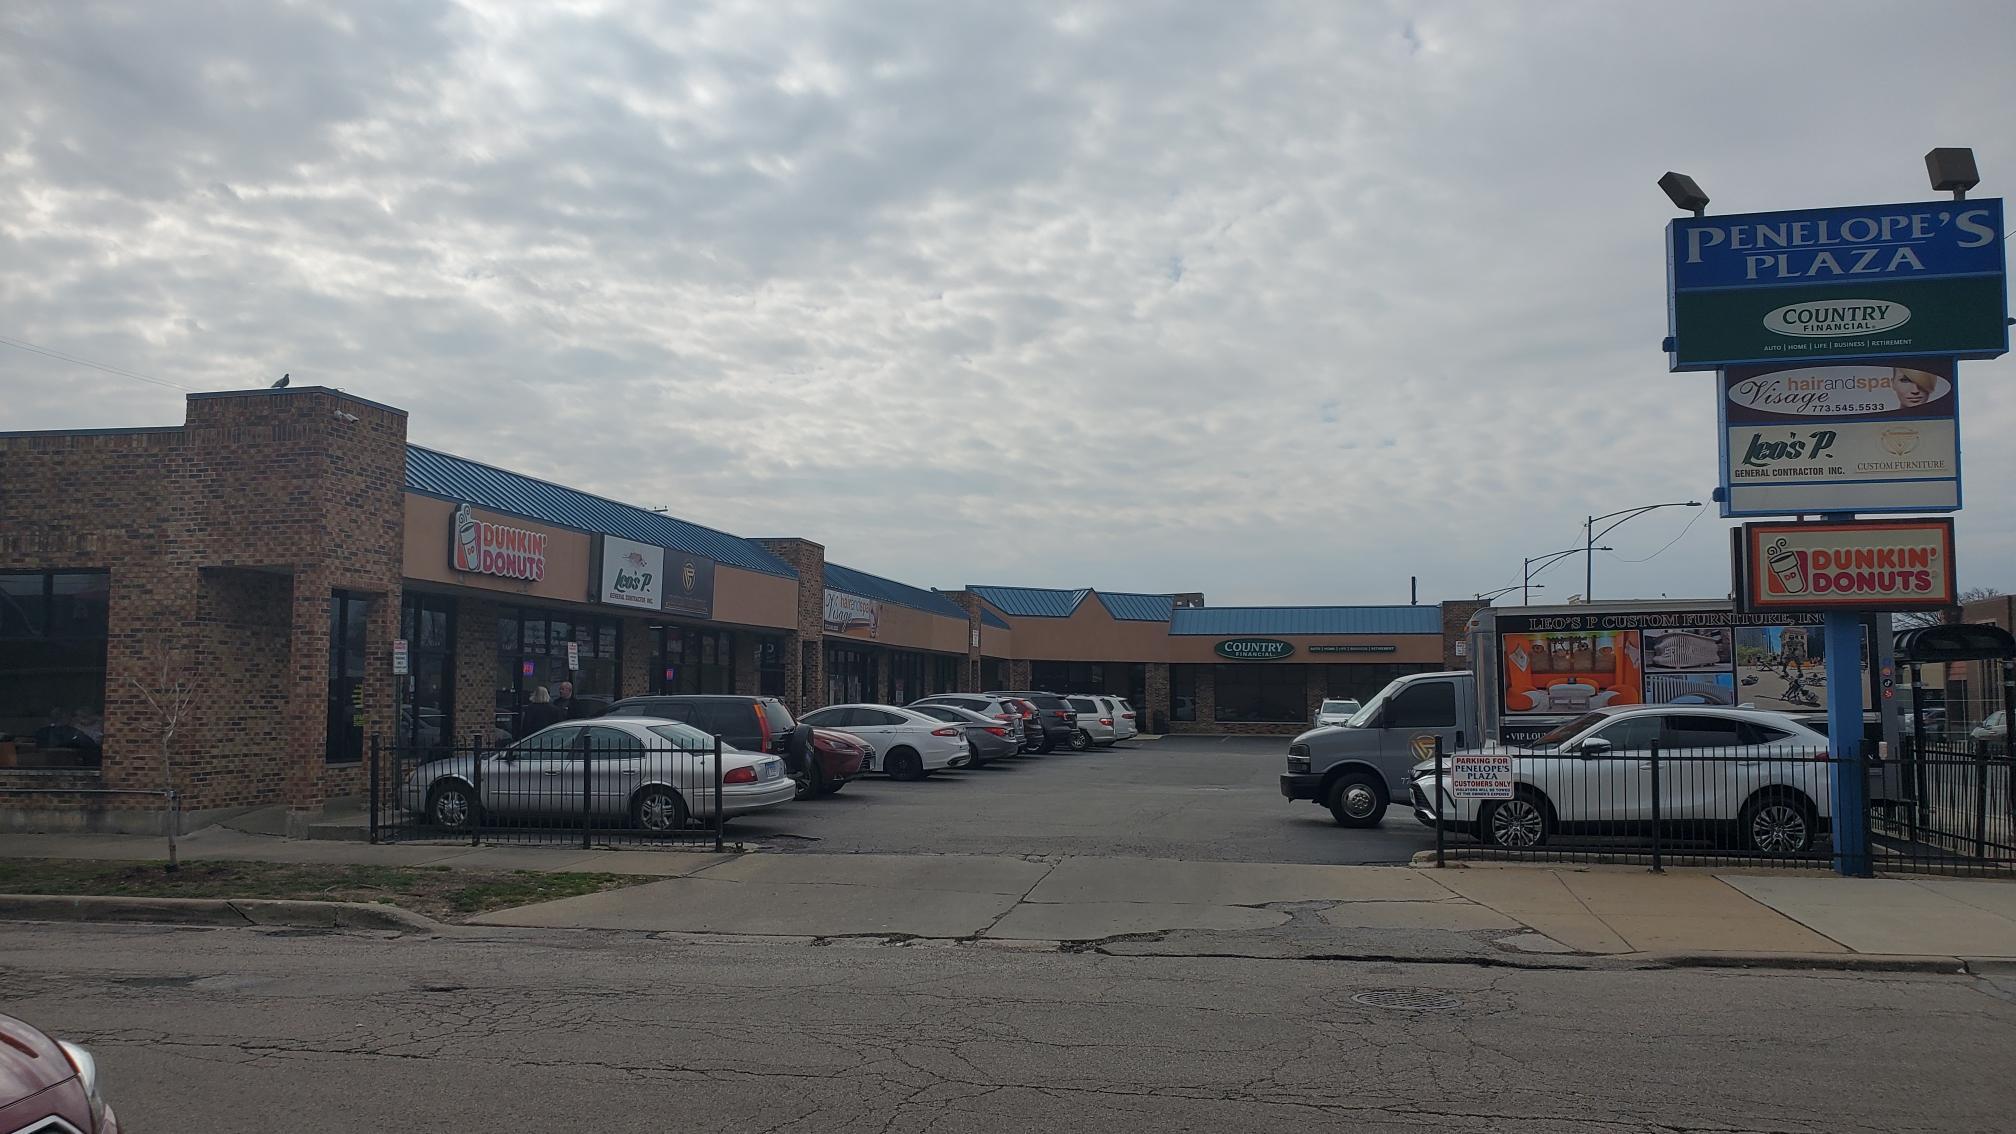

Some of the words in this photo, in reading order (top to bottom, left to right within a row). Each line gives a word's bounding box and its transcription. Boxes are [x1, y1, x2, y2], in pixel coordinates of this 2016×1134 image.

[1687, 209, 1995, 264] PENELOPE'S
[1745, 247, 1926, 280] PLAZA
[1782, 305, 1890, 324] COUNTRY
[1803, 322, 1871, 332] FINANCIAL
[1834, 340, 1865, 348] BUSINESS
[1871, 338, 1913, 346] RETIREMENT
[1739, 380, 1830, 413] Visage
[1811, 403, 1885, 413] 773.545.5533
[1741, 431, 1806, 468] Leo's
[1809, 430, 1837, 460] P.
[1734, 468, 1770, 478] GENERAL
[1772, 467, 1824, 477] CONTRACTOR
[1828, 466, 1845, 476] INC.
[483, 523, 547, 556] DUNKIN'
[482, 549, 544, 581] DONUTS
[1812, 547, 1937, 570] DUNKIN'
[1784, 572, 1797, 581] DD
[1812, 570, 1932, 593] DONUTS
[1529, 616, 1582, 631] LEO'S
[1586, 616, 1598, 629] P
[1602, 614, 1679, 628] CUSTOM
[1224, 641, 1284, 653] COUNTRY
[1510, 732, 1525, 740] VIP
[1455, 765, 1510, 773] PENELOPE'S
[1454, 780, 1493, 788] CUSTOMERS
[1494, 780, 1511, 788] ONLY
